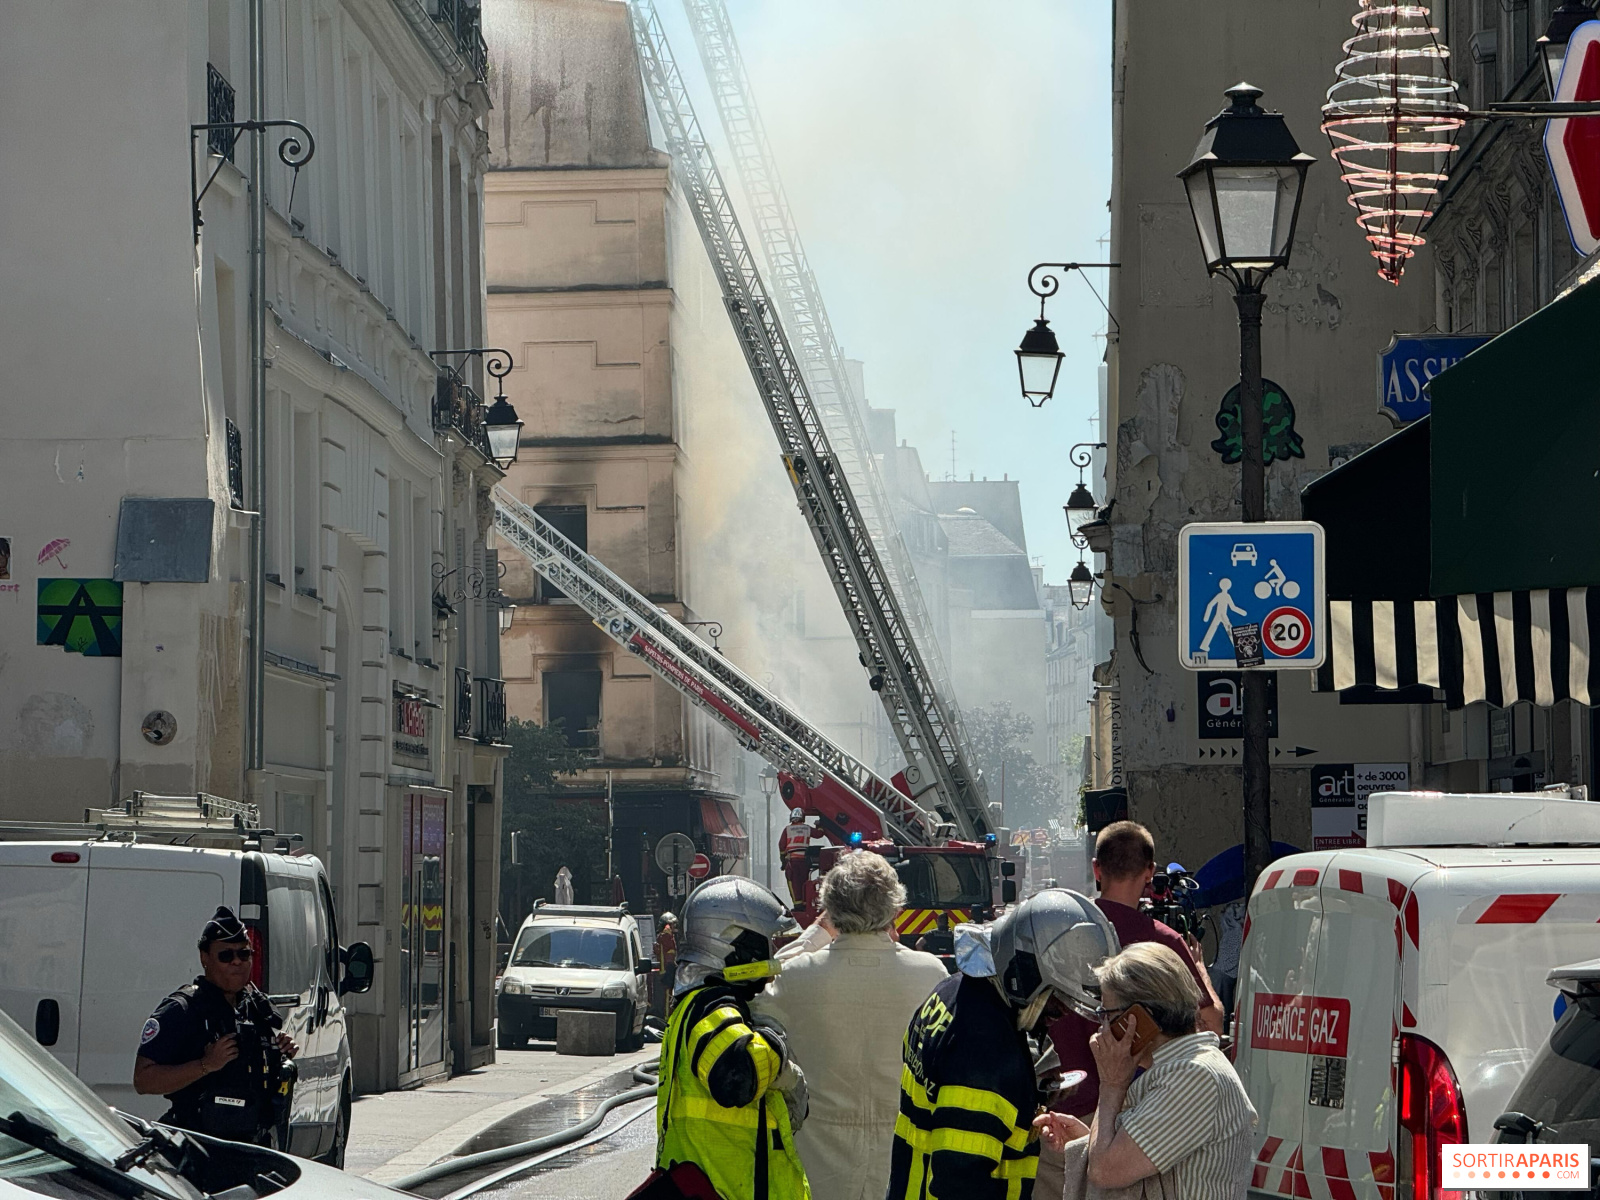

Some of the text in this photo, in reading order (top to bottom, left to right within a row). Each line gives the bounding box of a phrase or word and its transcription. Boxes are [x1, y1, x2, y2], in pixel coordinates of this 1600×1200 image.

[1273, 623, 1301, 641] 20
[690, 682, 703, 695] PARIS
[1112, 722, 1122, 742] des
[1112, 745, 1123, 786] MARQ
[1318, 770, 1355, 796] art
[1364, 771, 1378, 781] de
[1378, 771, 1406, 781] 3000
[1357, 783, 1396, 791] oeuvres
[1256, 1004, 1340, 1044] URGENCE GAZ
